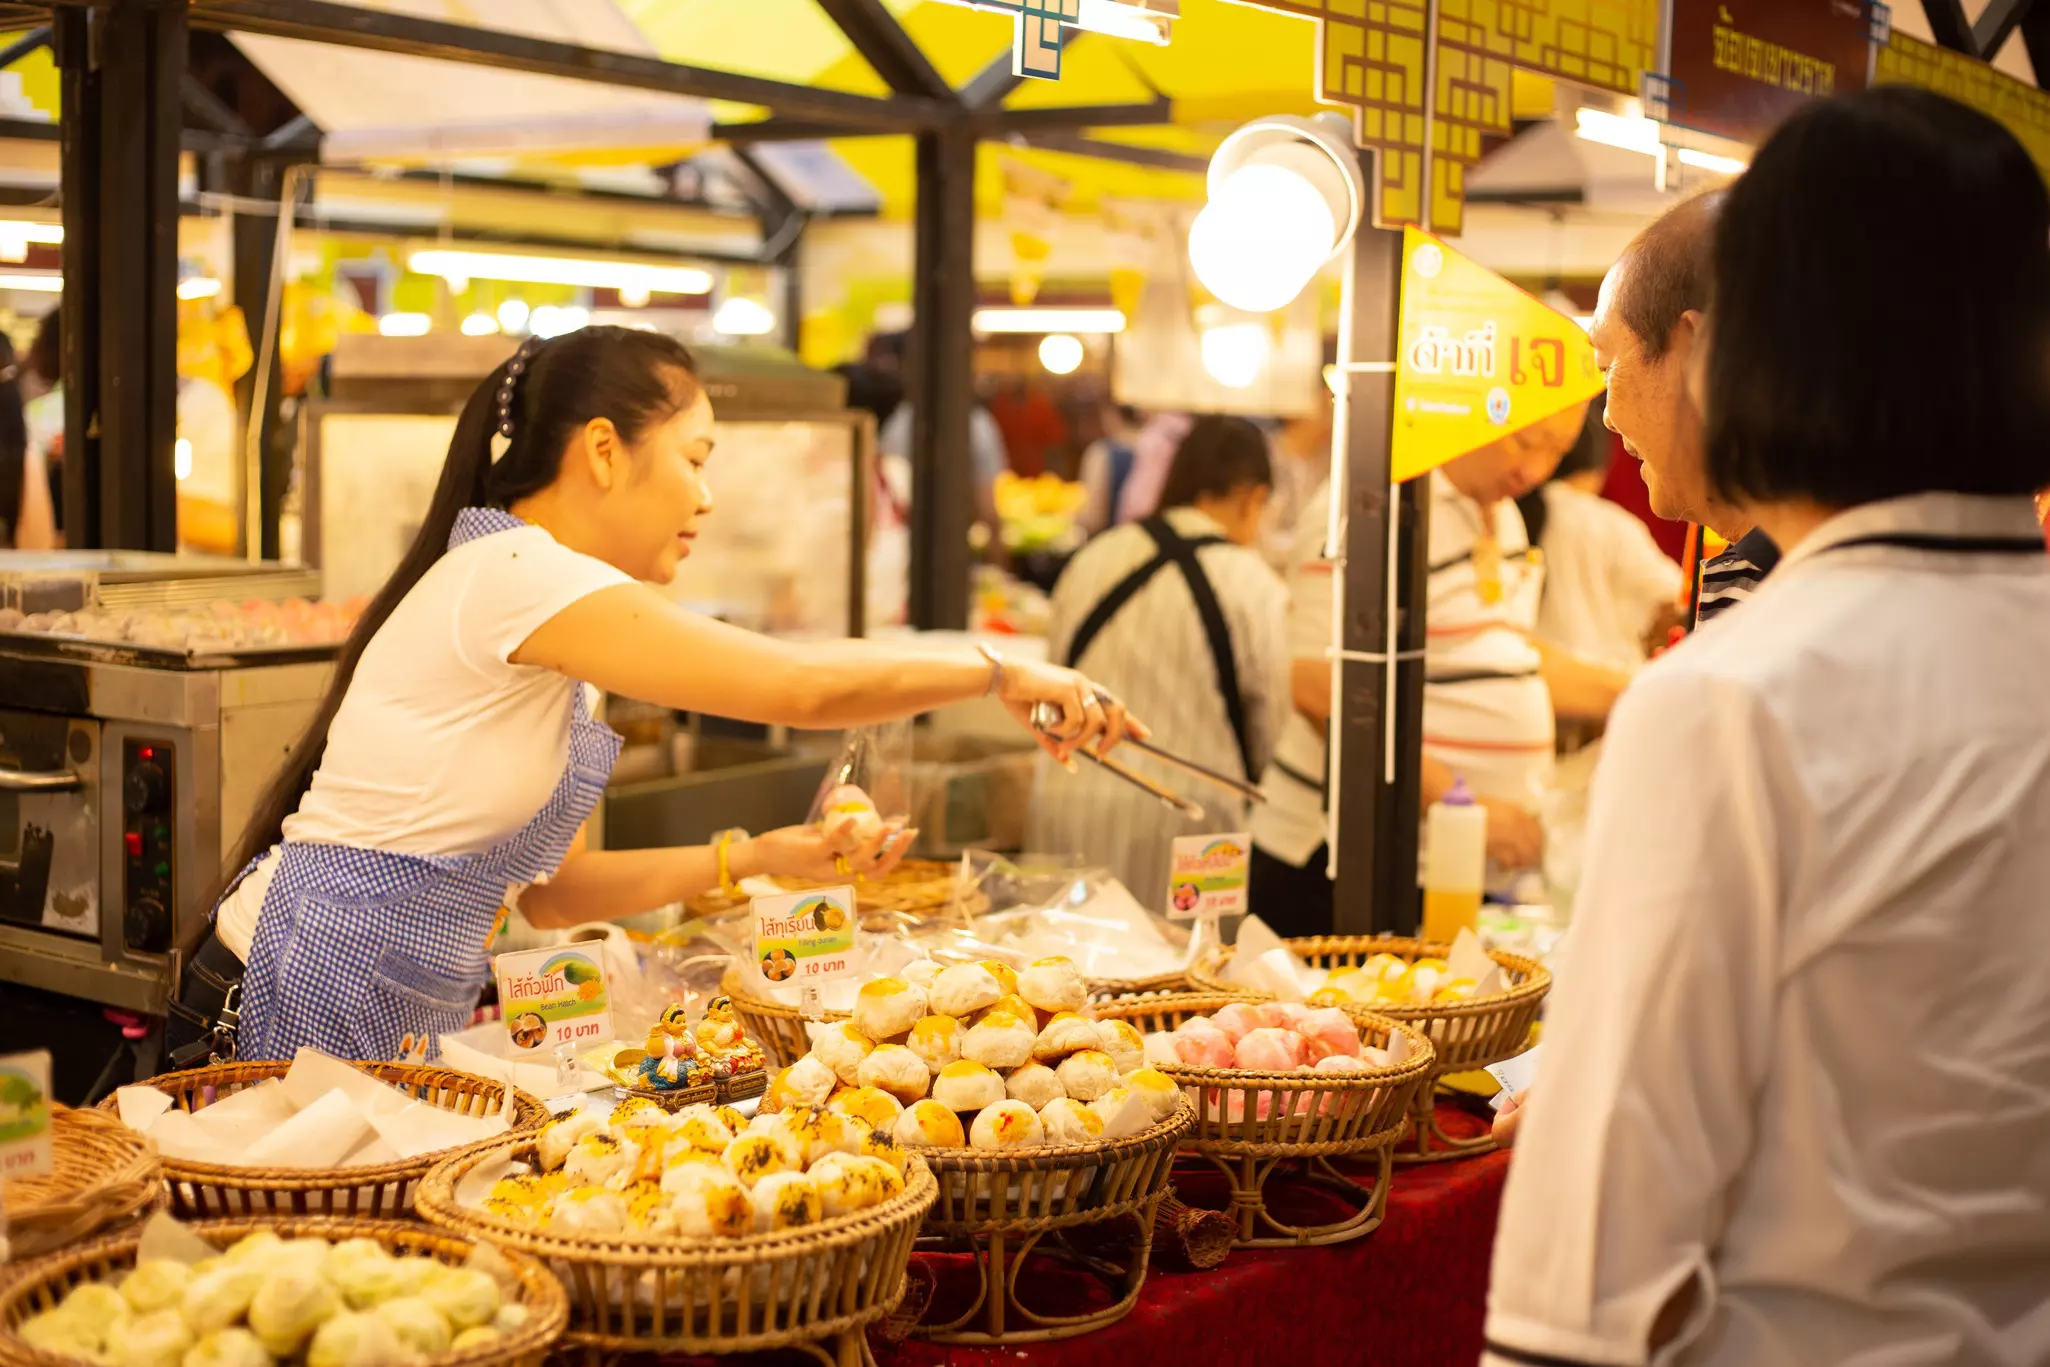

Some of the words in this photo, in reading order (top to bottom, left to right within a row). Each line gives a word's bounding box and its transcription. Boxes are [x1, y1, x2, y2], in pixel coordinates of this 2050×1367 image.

[805, 962, 819, 974] 10
[823, 959, 845, 972] บาท
[507, 971, 564, 998] ไส้ถั่วฟัก
[557, 1026, 572, 1041] 10
[576, 1023, 599, 1037] บาท
